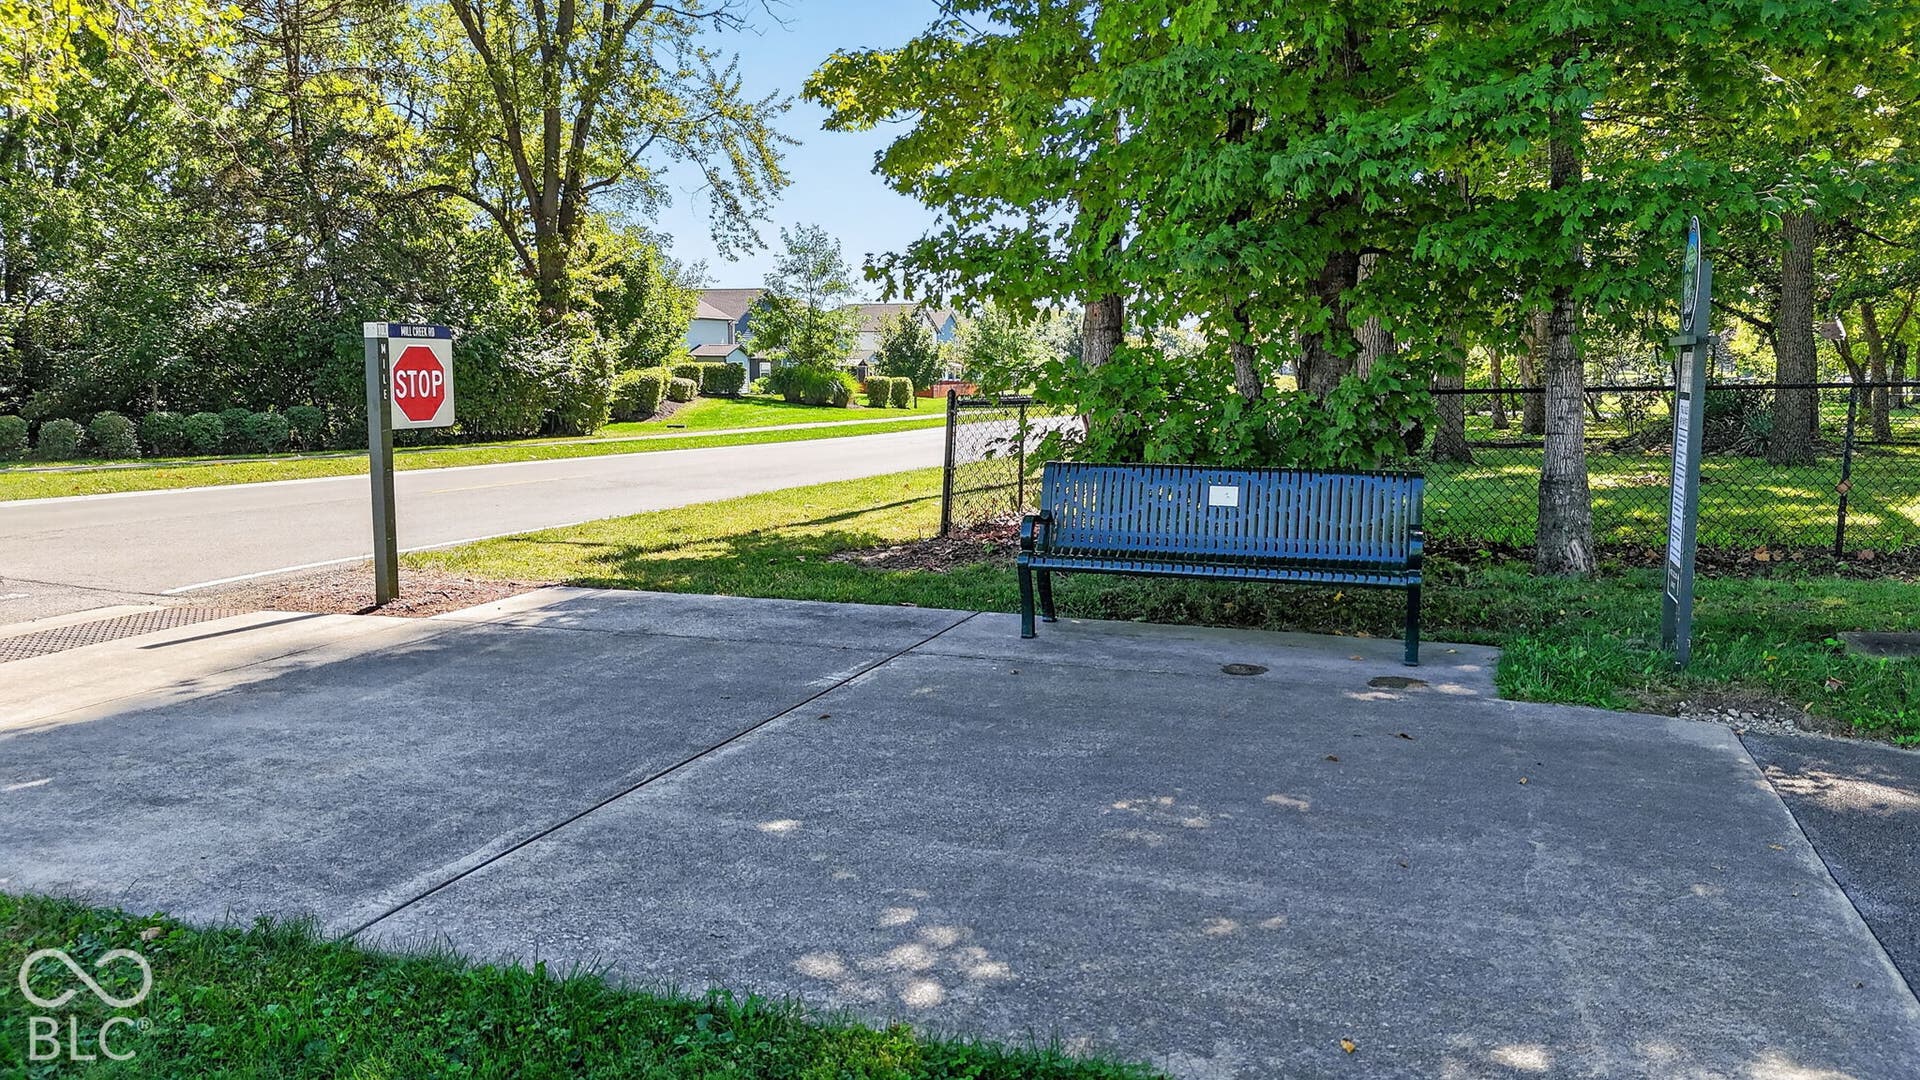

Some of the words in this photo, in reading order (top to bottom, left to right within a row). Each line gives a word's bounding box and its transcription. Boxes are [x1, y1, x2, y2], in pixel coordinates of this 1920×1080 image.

[400, 326, 412, 336] MILL
[412, 326, 428, 337] CREEK
[427, 327, 435, 337] RD
[395, 369, 443, 399] STOP
